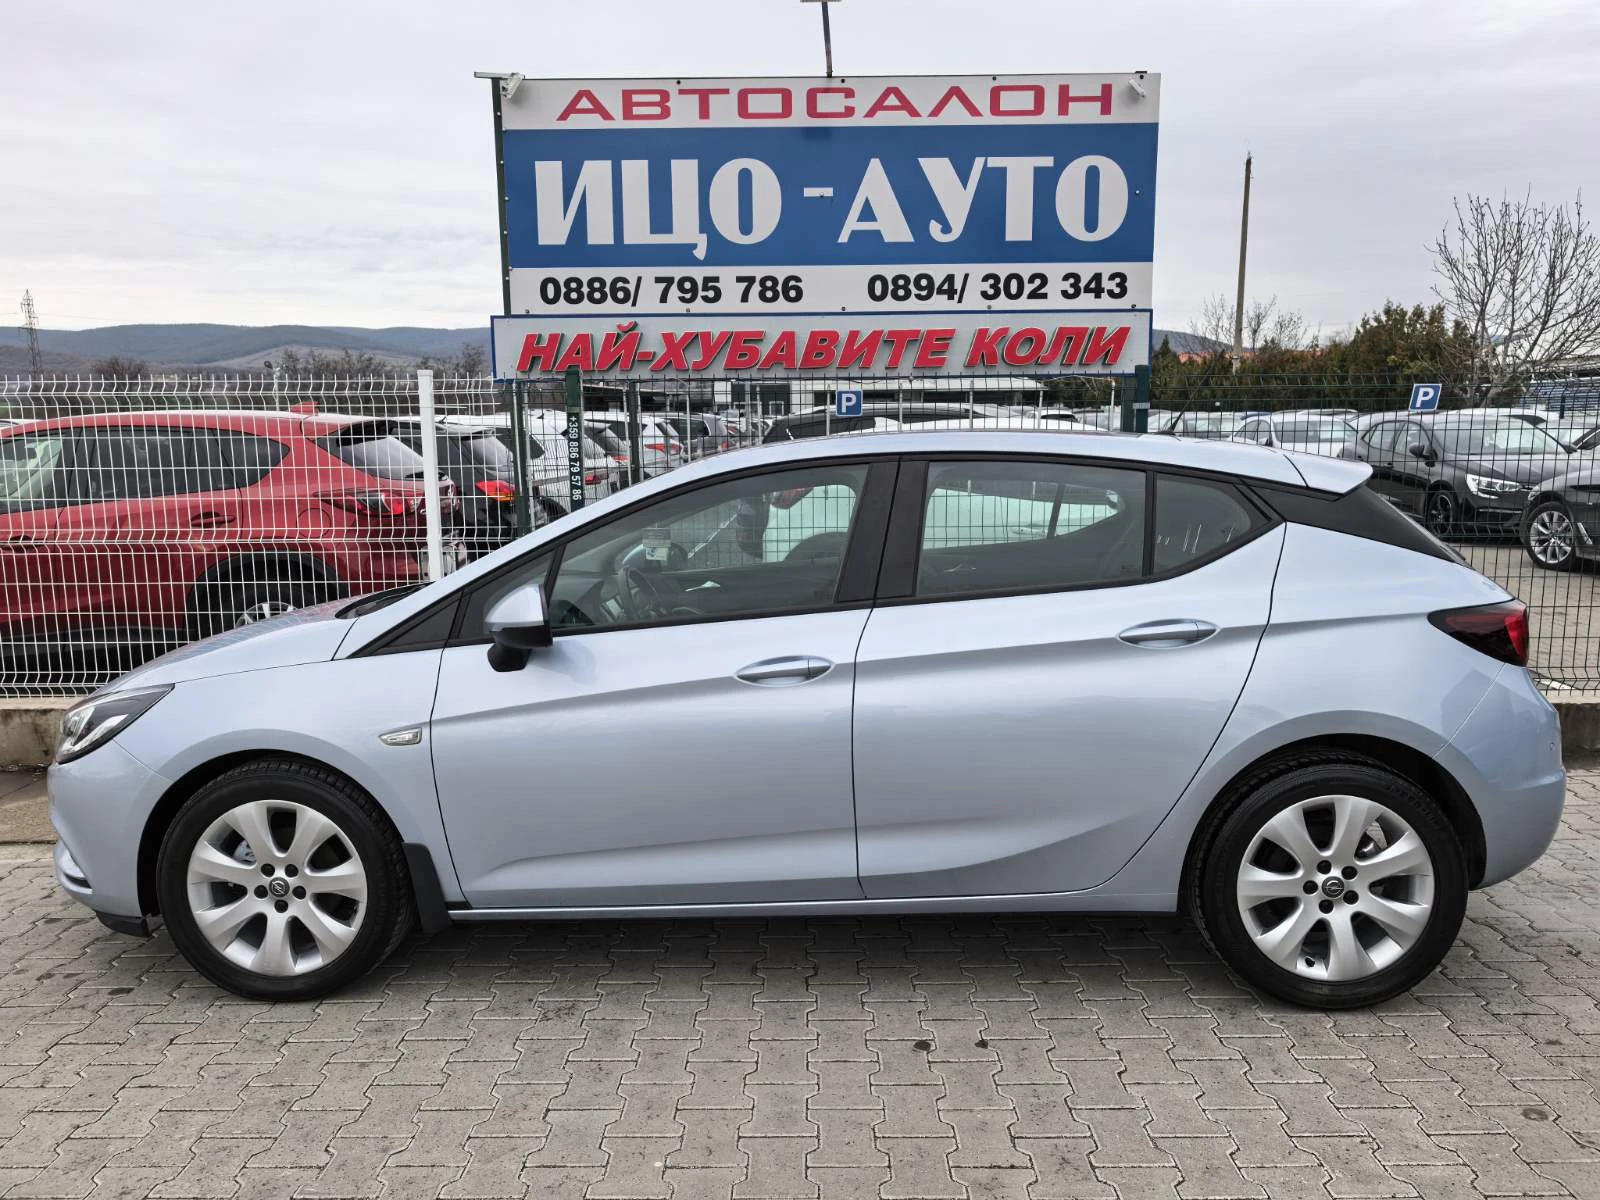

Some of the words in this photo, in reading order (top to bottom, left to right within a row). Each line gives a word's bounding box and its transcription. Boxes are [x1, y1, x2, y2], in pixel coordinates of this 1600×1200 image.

[556, 83, 1113, 122] АВТОСАЛОН
[539, 275, 643, 307] 0886/
[654, 275, 722, 304] 795
[735, 274, 804, 304] 786
[867, 272, 970, 304] 0894/
[980, 272, 1048, 303] 302
[1061, 271, 1128, 300] 343
[517, 321, 956, 372] НАЙ-ХУБАВИТЕ
[963, 325, 1131, 368] КОЛИ
[841, 393, 856, 412] P
[1415, 387, 1434, 408] P
[568, 415, 579, 439] +359
[569, 441, 579, 459] 886
[570, 461, 580, 473] 79
[571, 475, 581, 486] 57
[572, 489, 582, 501] 86
